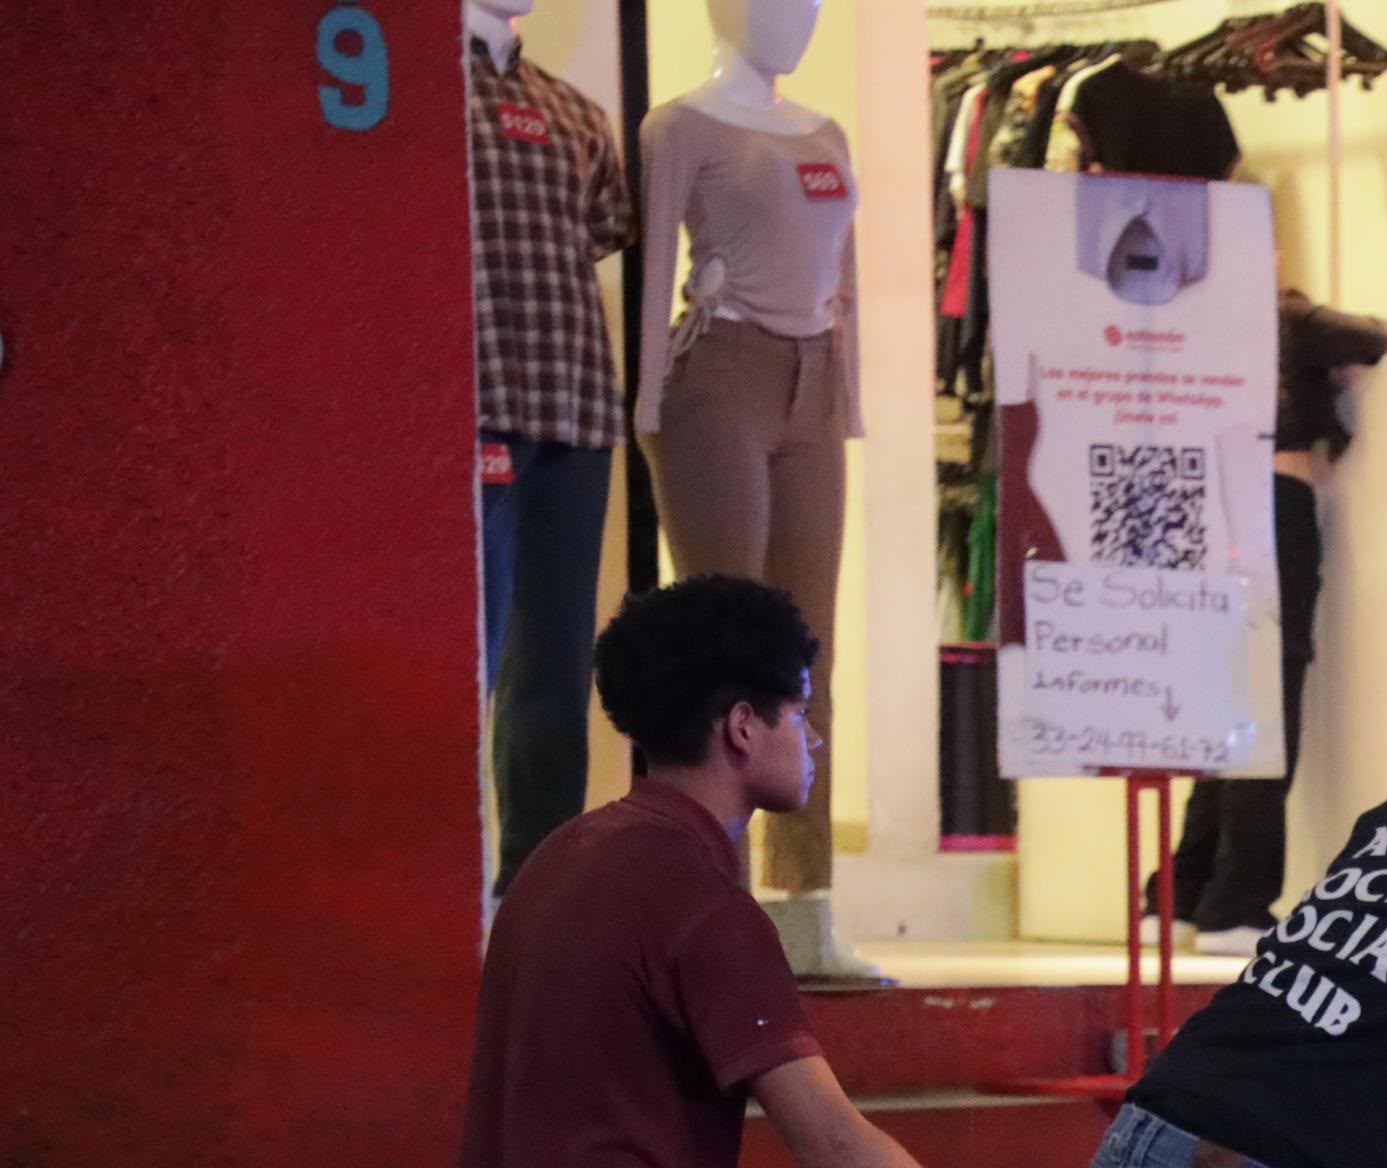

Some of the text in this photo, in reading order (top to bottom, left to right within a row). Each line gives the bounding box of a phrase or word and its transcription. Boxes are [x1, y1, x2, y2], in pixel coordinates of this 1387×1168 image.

[316, 6, 390, 131] 9
[1030, 565, 1085, 608] Se
[1032, 618, 1169, 656] Personal
[1243, 951, 1362, 1037] CLUB
